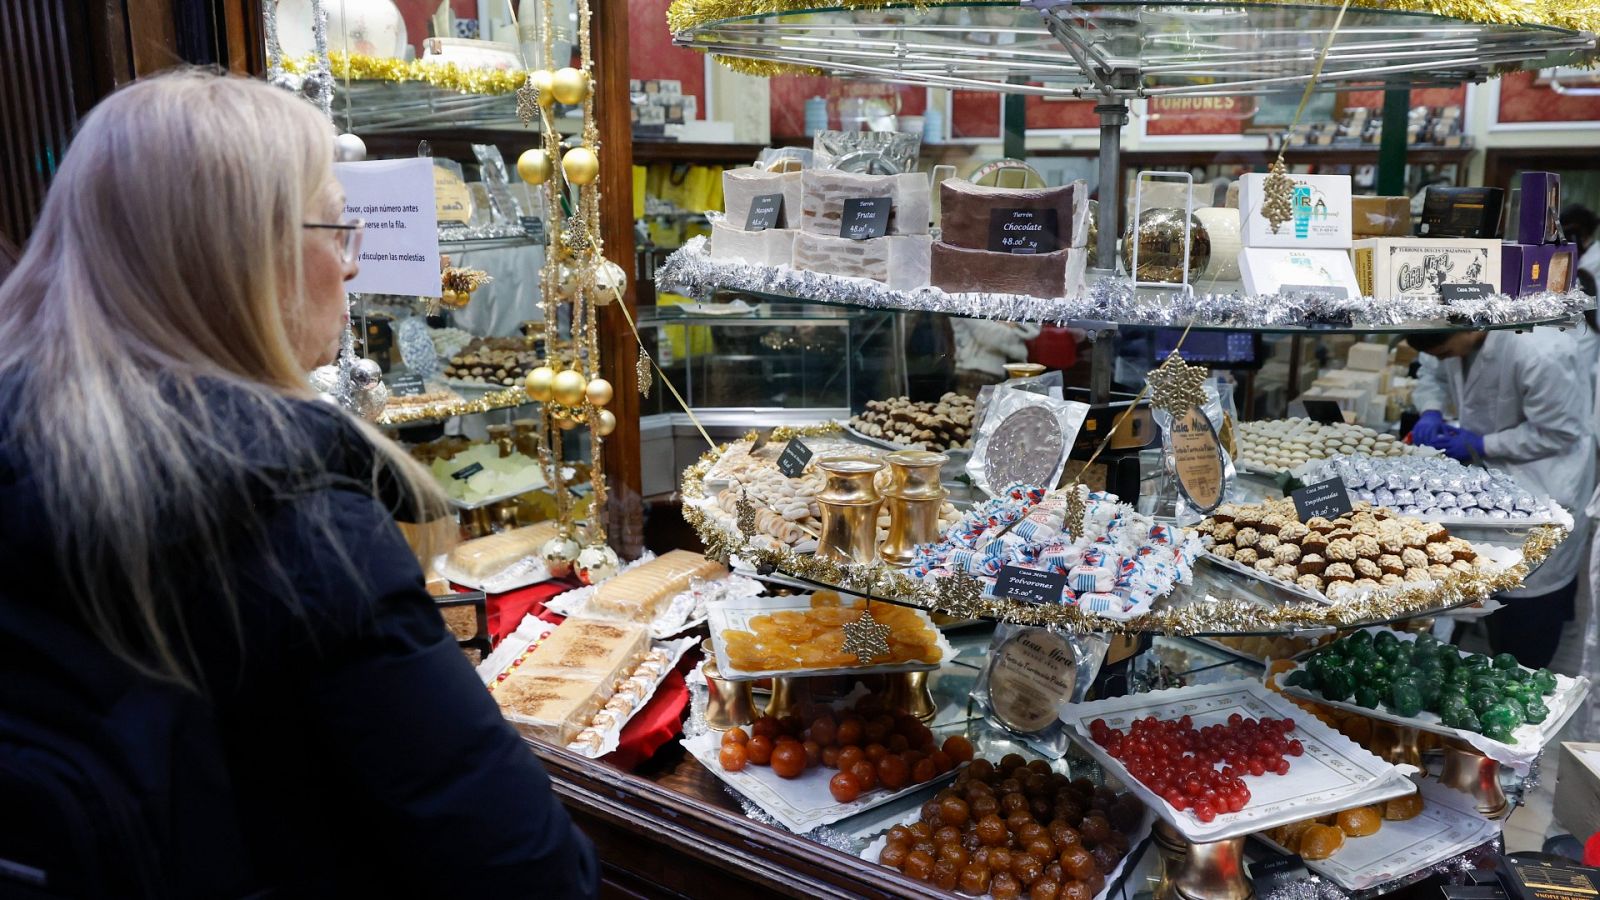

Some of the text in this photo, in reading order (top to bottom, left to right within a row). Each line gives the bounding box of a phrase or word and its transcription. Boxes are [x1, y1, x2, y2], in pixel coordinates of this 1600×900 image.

[1294, 196, 1326, 207] IRA
[346, 204, 419, 214] favor, cojan número antes
[856, 211, 876, 220] Frutas
[389, 220, 395, 229] la
[1003, 222, 1043, 231] Chocolate
[362, 252, 389, 262] disculpen
[389, 252, 398, 261] las
[398, 252, 426, 262] molestias
[1397, 262, 1423, 293] Casa
[1009, 576, 1054, 589] Polvorones
[1017, 632, 1072, 667] Casa Mira
